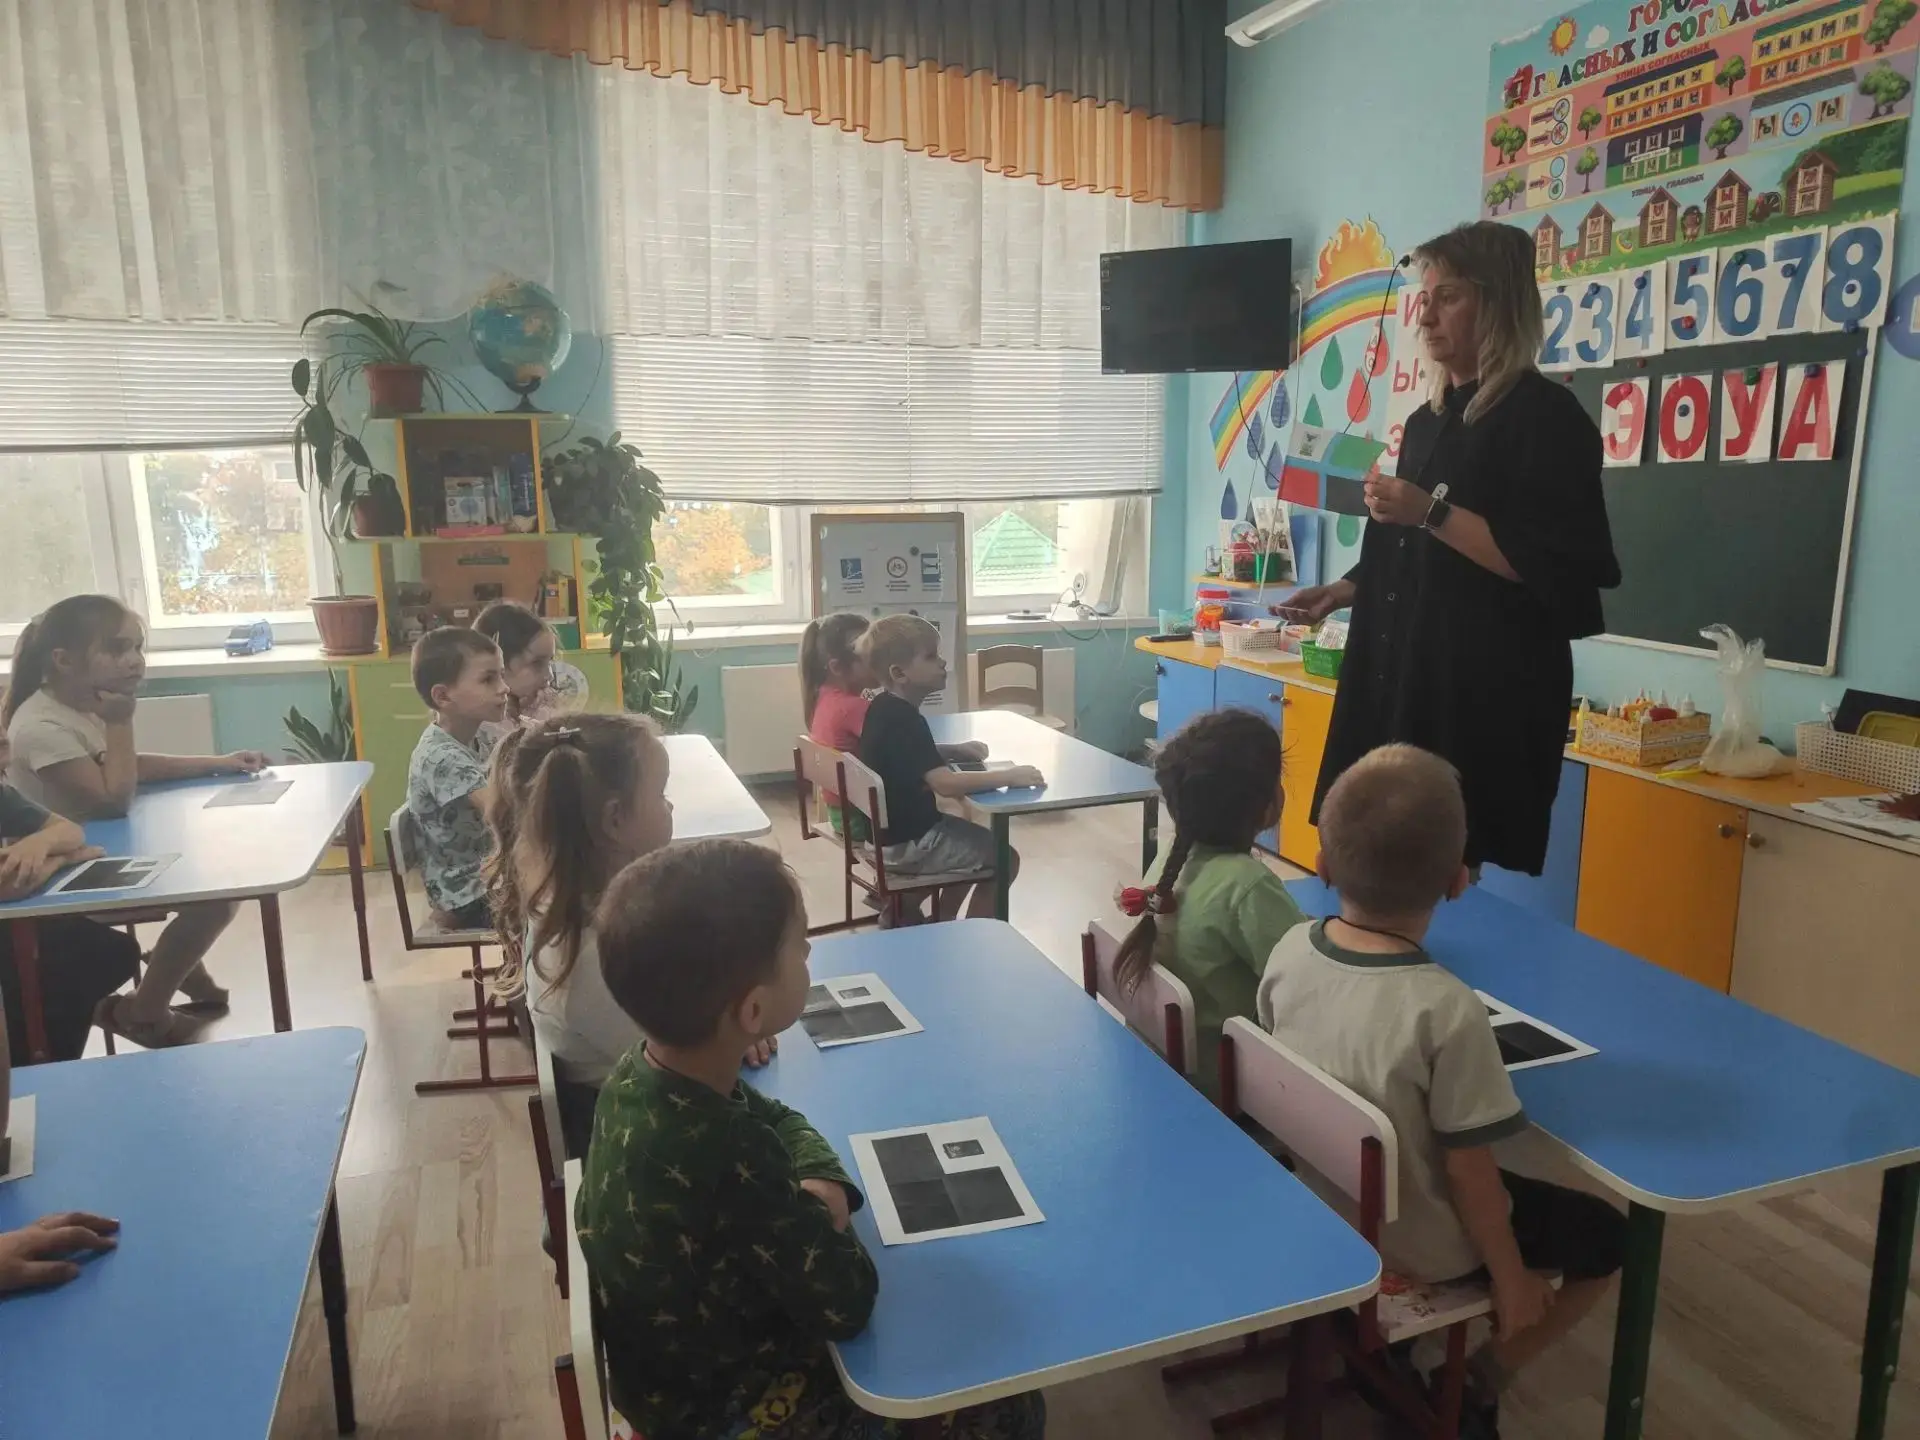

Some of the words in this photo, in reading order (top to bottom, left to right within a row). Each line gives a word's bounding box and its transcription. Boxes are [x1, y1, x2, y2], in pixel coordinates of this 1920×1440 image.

[1532, 38, 1637, 98] ГЛАСНЫХ
[1641, 29, 1660, 57] И
[1664, 0, 1799, 48] СОГЛАС
[1647, 40, 1711, 70] СОГЛАСНЫХ
[1538, 294, 1573, 365] 2
[1575, 284, 1614, 364] 3
[1626, 271, 1654, 350] 4
[1670, 256, 1710, 341] 5
[1716, 249, 1767, 337] 6
[1773, 233, 1822, 329] 7
[1822, 226, 1883, 323] 8
[1393, 357, 1419, 392] Ы
[1603, 382, 1646, 461] Э
[1660, 375, 1710, 460] О
[1723, 363, 1778, 457] У
[1778, 365, 1833, 459] А
